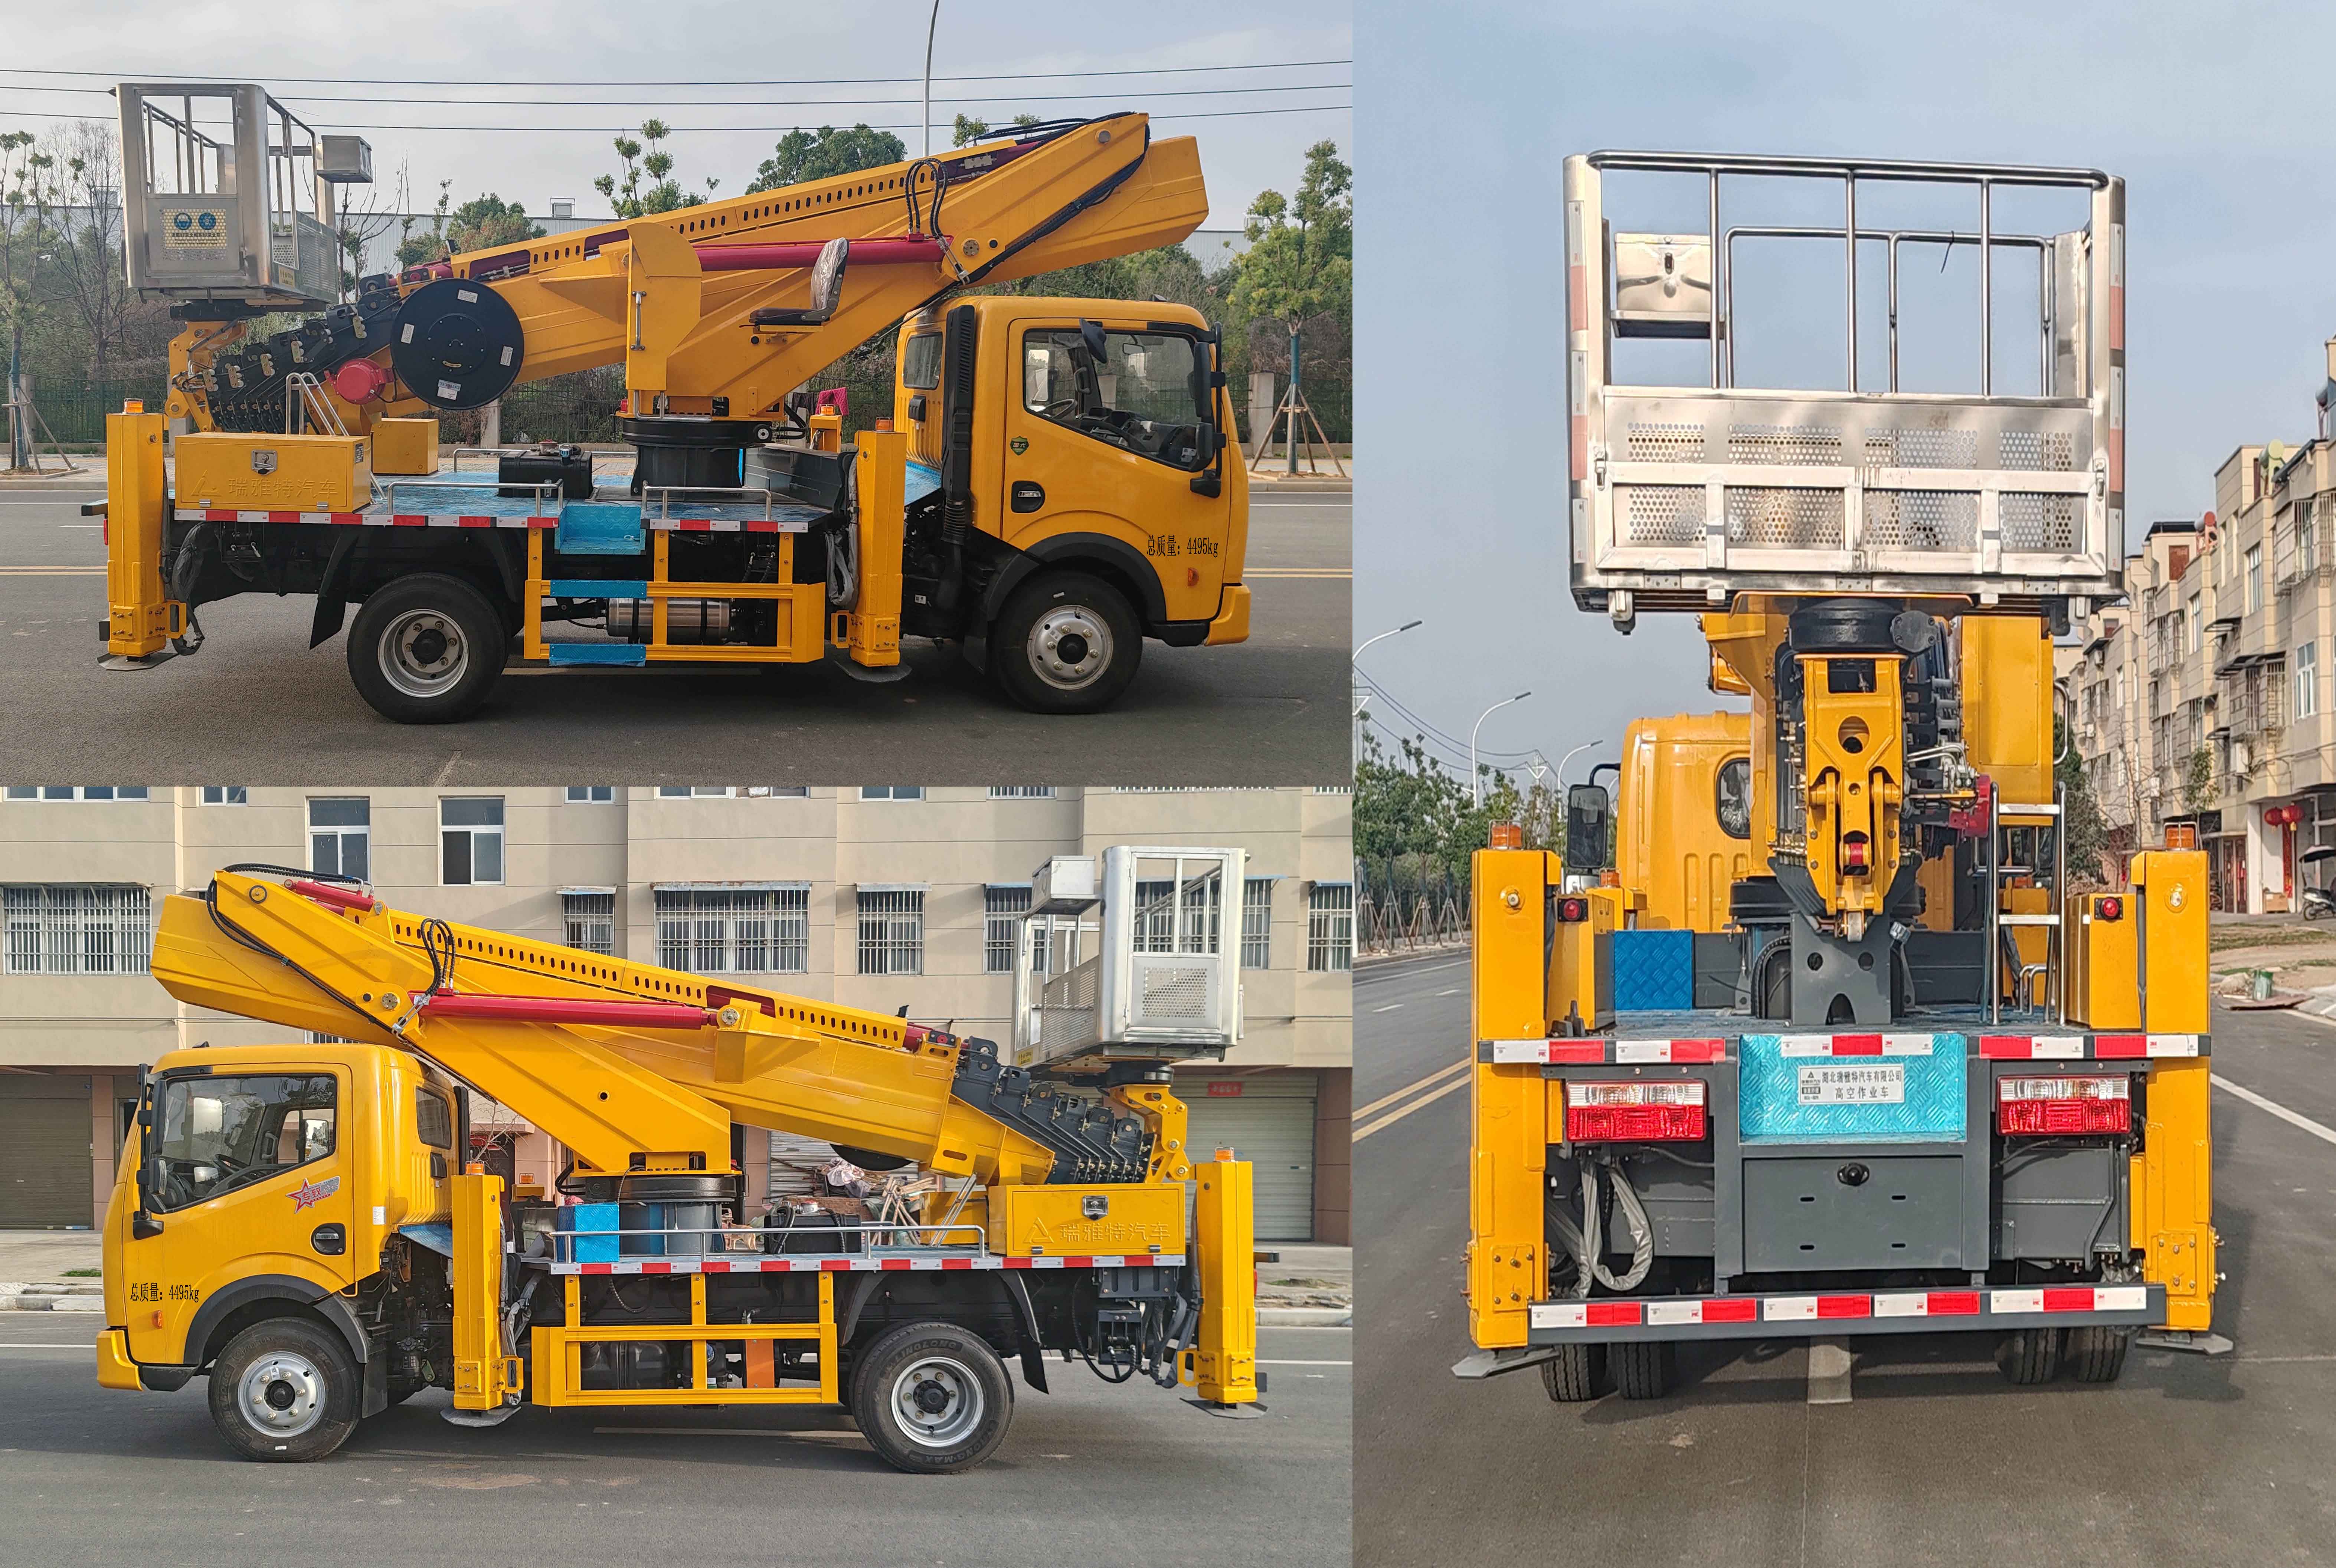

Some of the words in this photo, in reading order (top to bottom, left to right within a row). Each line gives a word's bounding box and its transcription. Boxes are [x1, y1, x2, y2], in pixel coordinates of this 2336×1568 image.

[228, 477, 338, 498] 瑞雅特汽车
[1822, 1070, 1901, 1084] 湖北瑞雅特汽车有限公司
[1835, 1086, 1889, 1100] 高空作业车
[1059, 1221, 1170, 1241] 瑞雅特汽车
